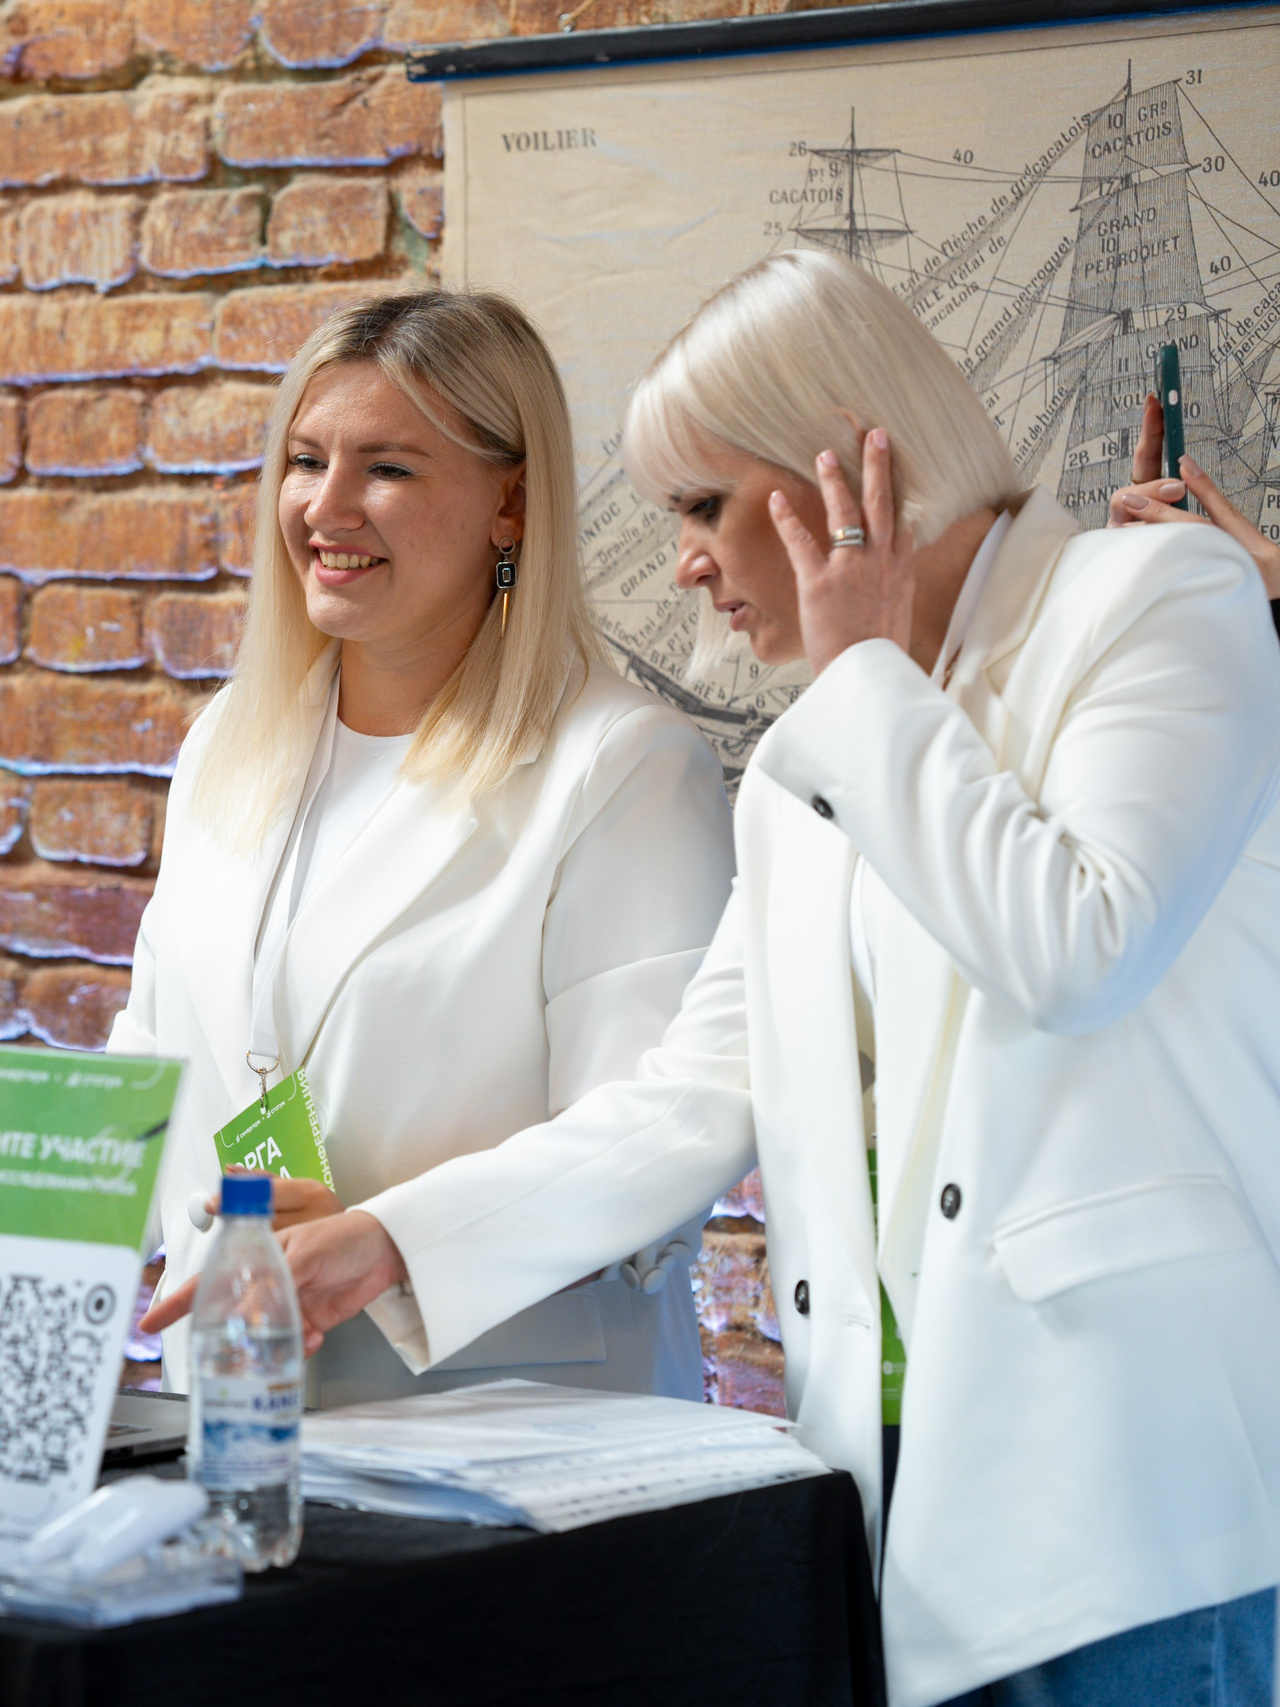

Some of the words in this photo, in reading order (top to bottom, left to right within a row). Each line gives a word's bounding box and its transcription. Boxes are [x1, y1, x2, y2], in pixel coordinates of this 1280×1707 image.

[1185, 69, 1203, 86] 31
[1108, 113, 1124, 129] 10
[501, 126, 597, 153] VOILIER
[1091, 121, 1172, 159] CACATOIS
[789, 141, 807, 158] 26
[952, 147, 974, 165] 40
[829, 161, 839, 178] 9
[1202, 155, 1225, 174] 30
[1258, 170, 1280, 187] 40
[770, 187, 845, 206] CACATOIS
[763, 221, 783, 237] 25
[1098, 207, 1157, 238] GRAND
[924, 255, 942, 275] de
[990, 194, 1009, 215] de
[989, 235, 1007, 256] de
[1102, 237, 1117, 253] 10
[1085, 235, 1181, 278] PERROQUET
[1210, 256, 1232, 275] 40
[975, 306, 1013, 361] grand
[1012, 236, 1073, 317] perroquet
[1165, 304, 1187, 322] 29
[1236, 317, 1254, 337] de
[1146, 333, 1199, 359] GND
[1028, 421, 1043, 440] de
[1102, 441, 1118, 457] 16
[620, 551, 668, 598] GRAND
[749, 663, 759, 679] 9
[756, 694, 766, 709] 6
[39, 1134, 147, 1168] УЧАСТИЕ
